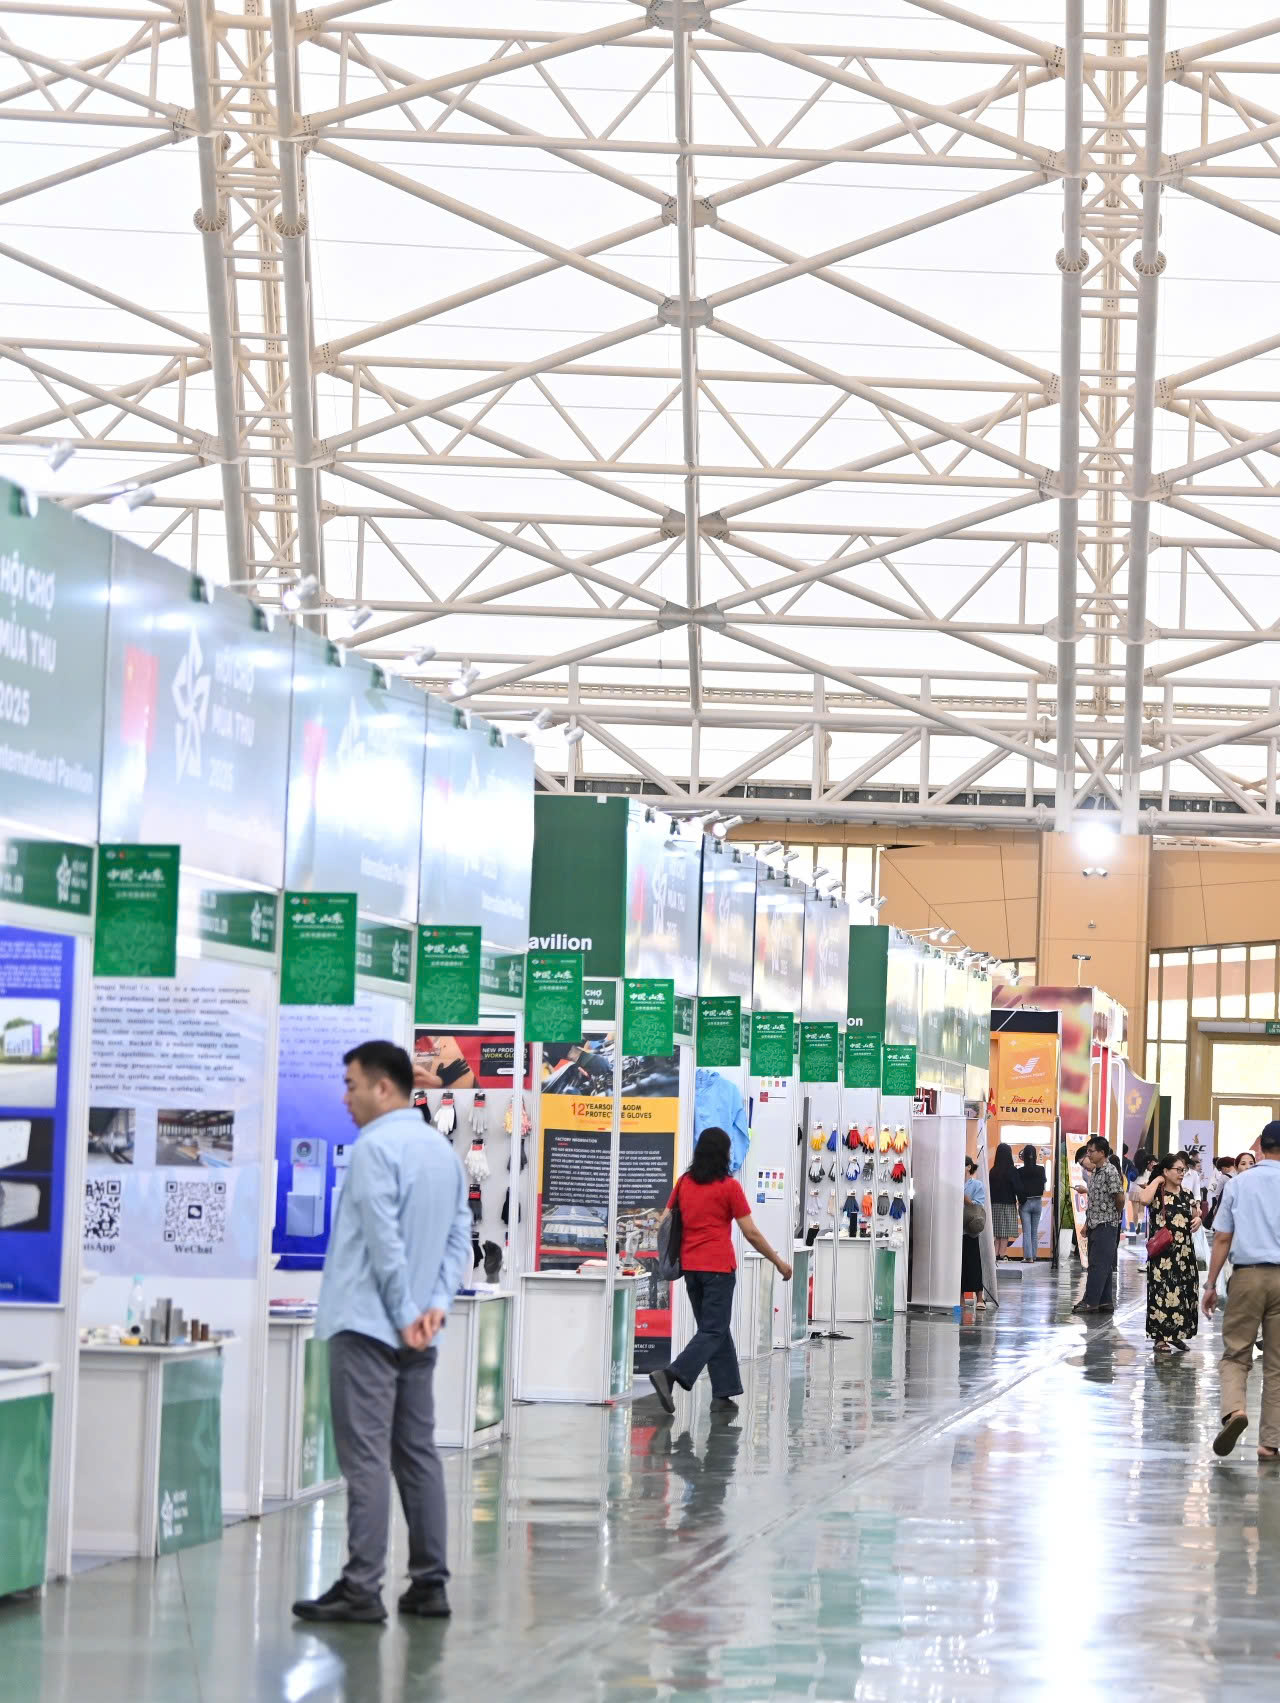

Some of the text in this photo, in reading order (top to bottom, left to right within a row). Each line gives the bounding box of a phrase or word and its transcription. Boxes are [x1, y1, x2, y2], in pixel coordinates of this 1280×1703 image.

[30, 630, 56, 673] THU
[528, 933, 593, 950] avilion
[571, 1102, 586, 1116] 12
[174, 1244, 213, 1254] WeChat
